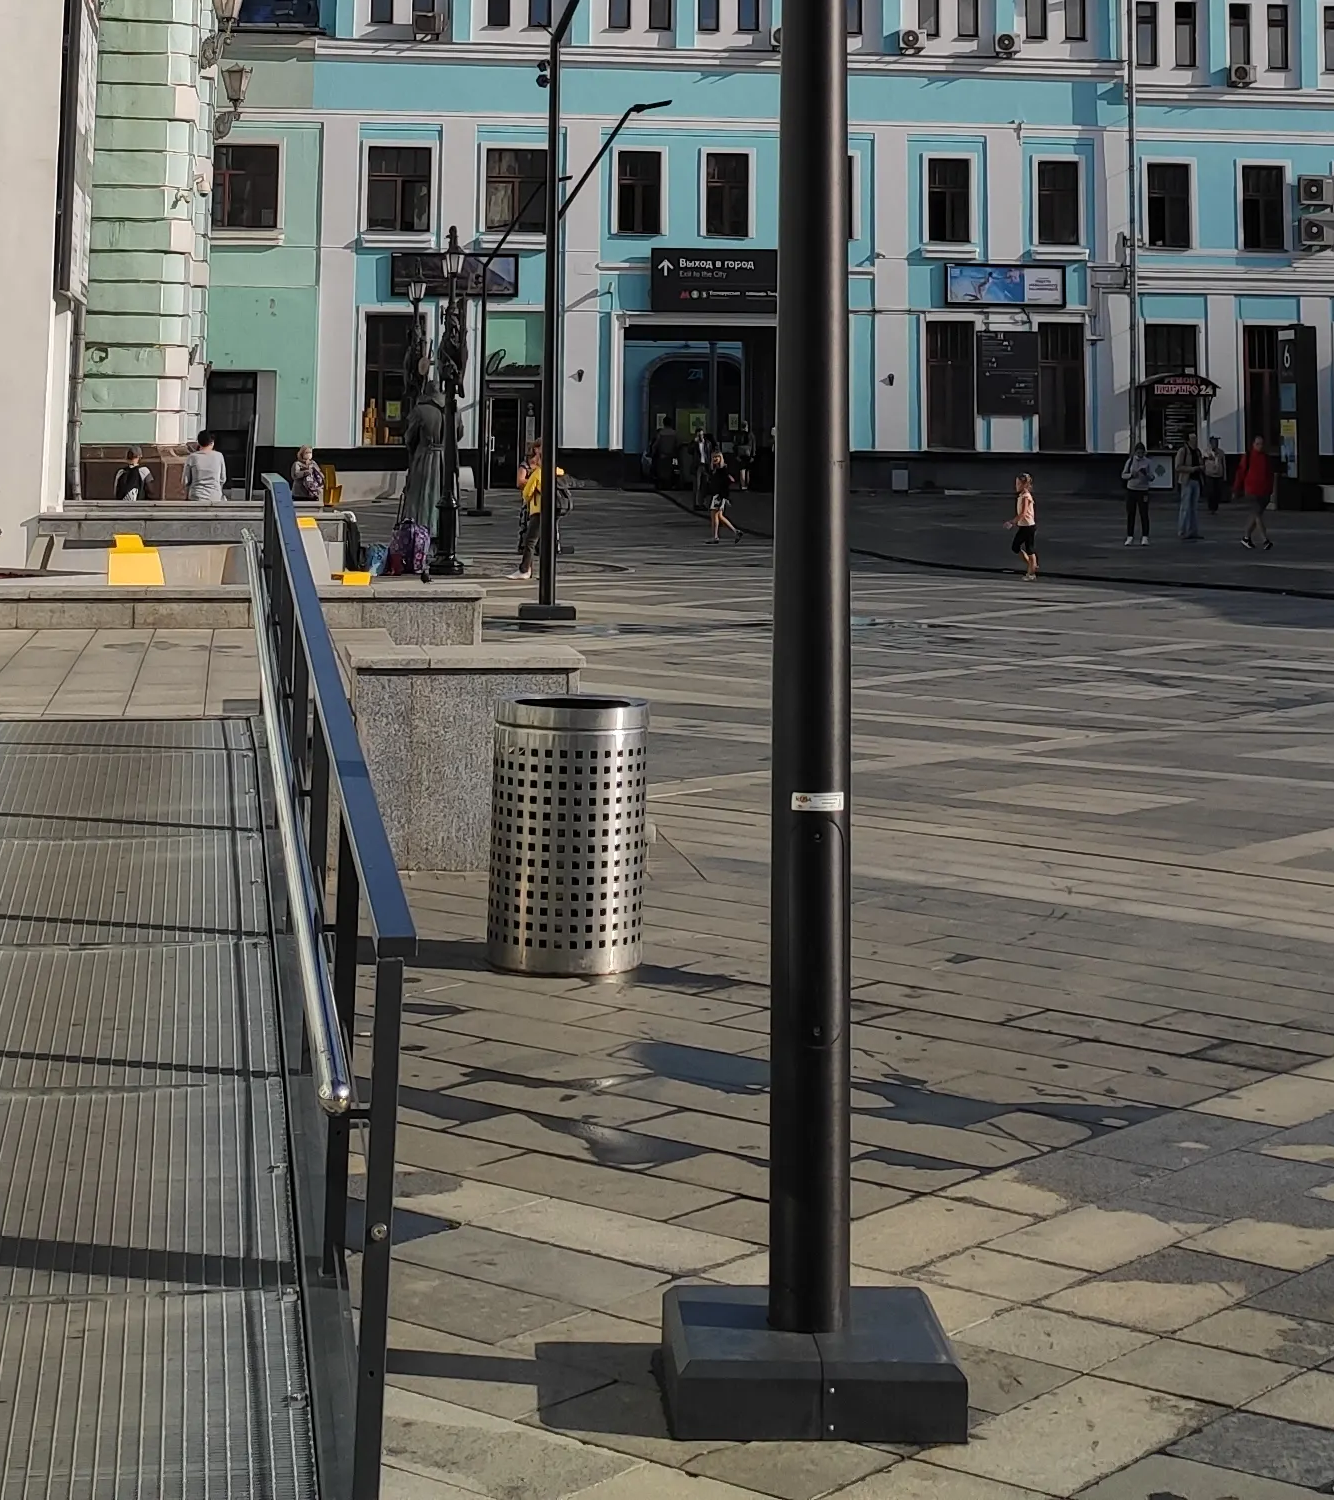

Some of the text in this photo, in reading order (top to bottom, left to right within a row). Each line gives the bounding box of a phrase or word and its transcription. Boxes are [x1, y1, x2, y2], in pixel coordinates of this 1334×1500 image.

[679, 258, 755, 270] Выход в город
[713, 270, 727, 279] City
[1283, 343, 1291, 369] 6
